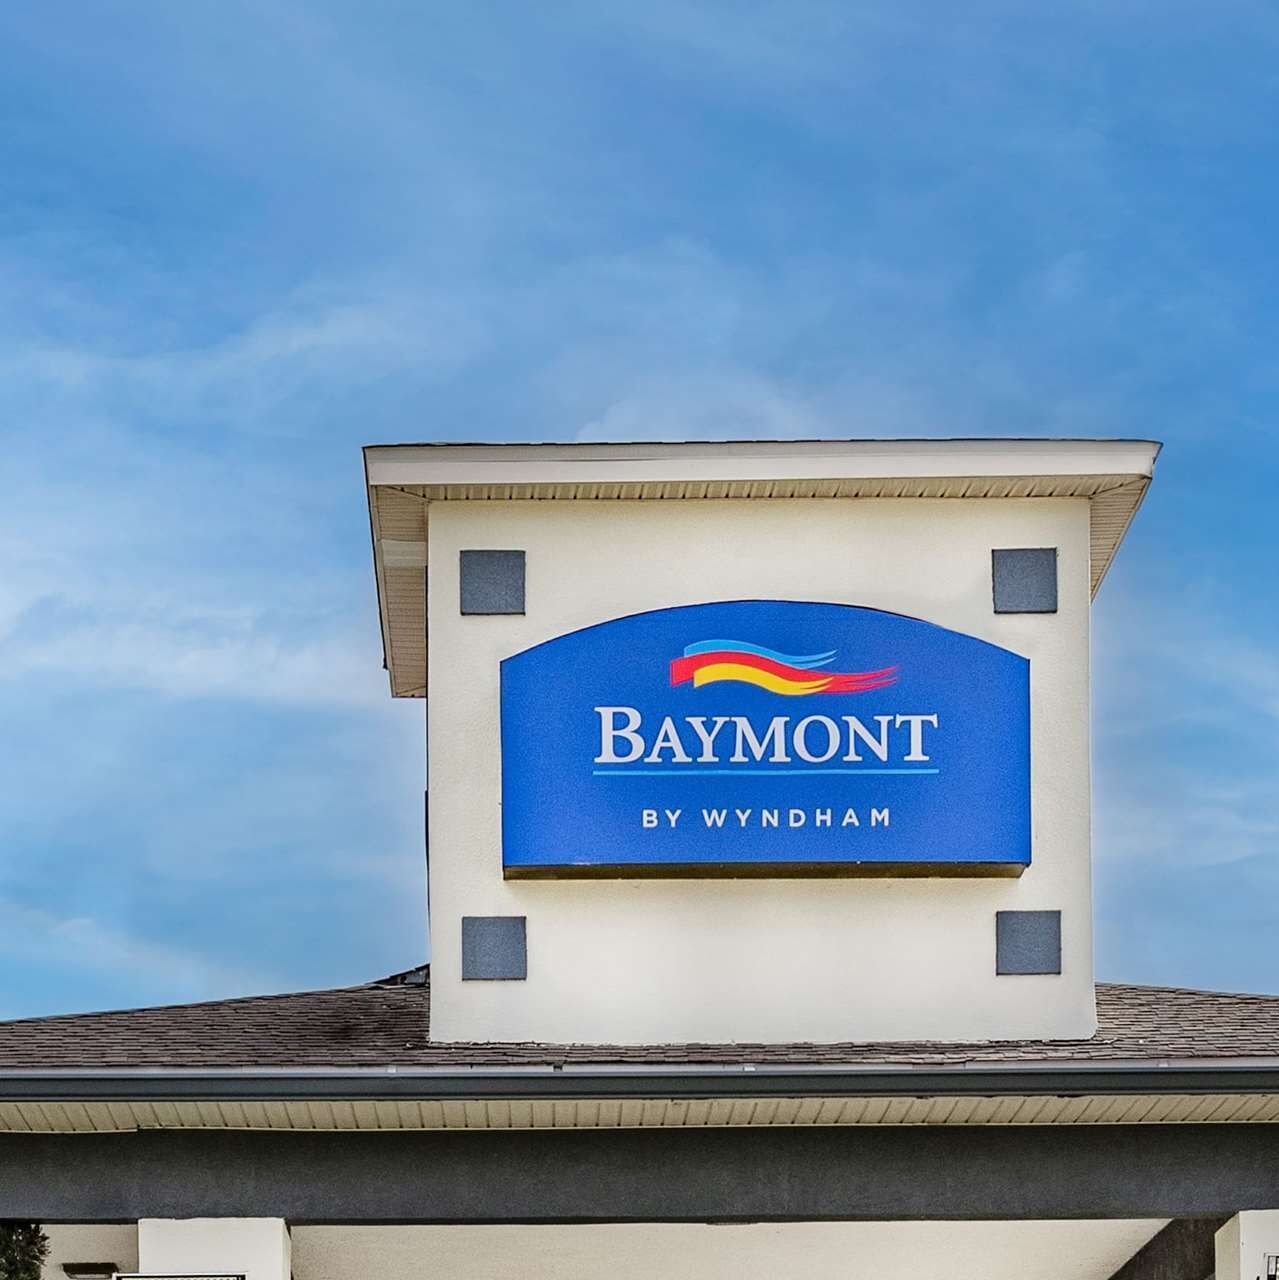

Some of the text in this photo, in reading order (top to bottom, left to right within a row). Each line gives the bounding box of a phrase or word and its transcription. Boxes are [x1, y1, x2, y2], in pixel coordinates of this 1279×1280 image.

[594, 706, 938, 763] BAYMONT
[641, 808, 890, 828] BY WYNDHAM
